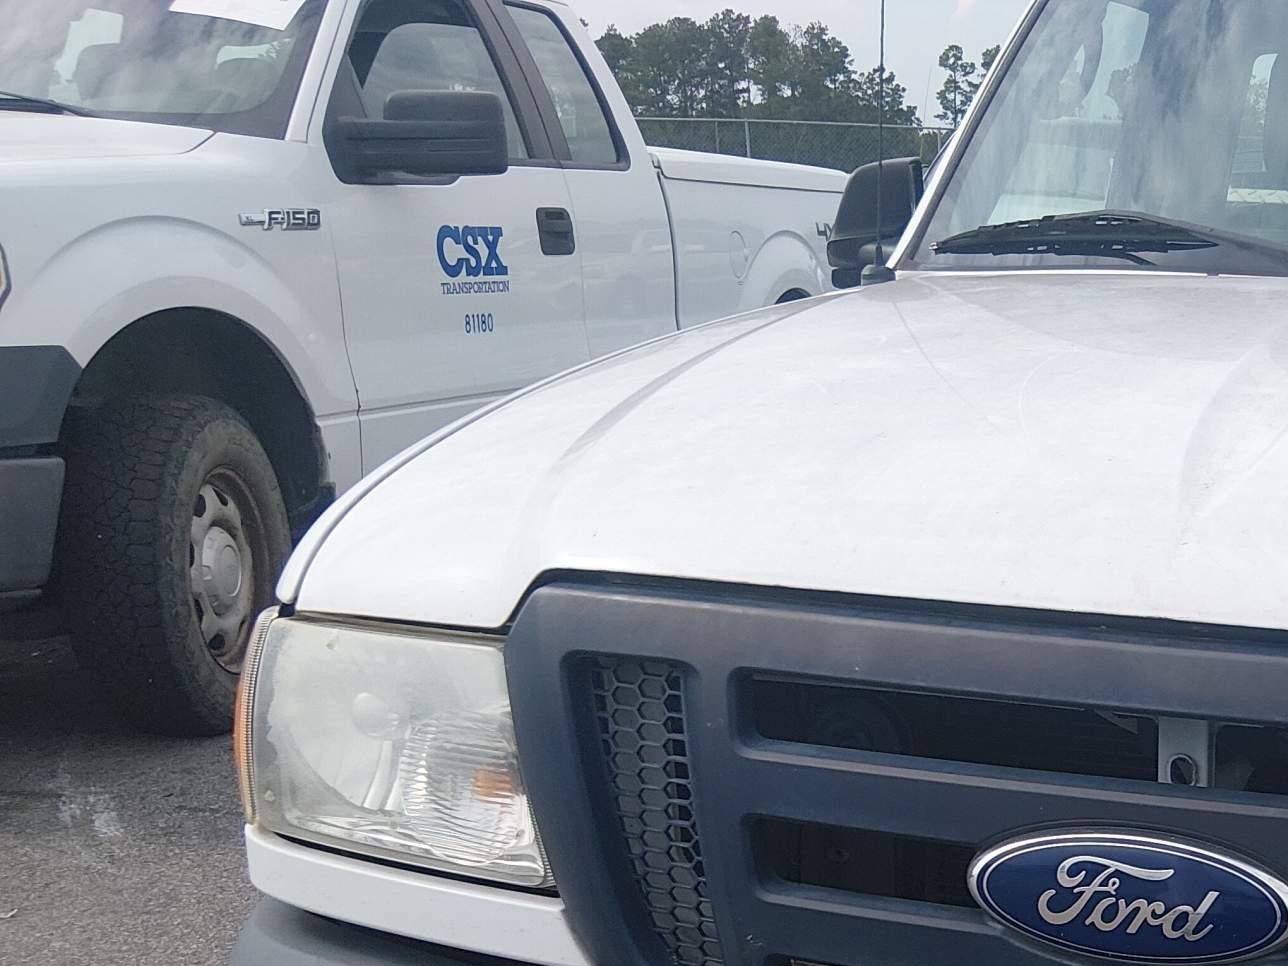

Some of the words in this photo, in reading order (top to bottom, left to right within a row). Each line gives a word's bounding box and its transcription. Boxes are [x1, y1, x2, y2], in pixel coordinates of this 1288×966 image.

[436, 224, 508, 278] CSX
[441, 281, 510, 295] TRANSPORTATION
[464, 313, 494, 333] 81180
[1037, 855, 1220, 942] Ford
